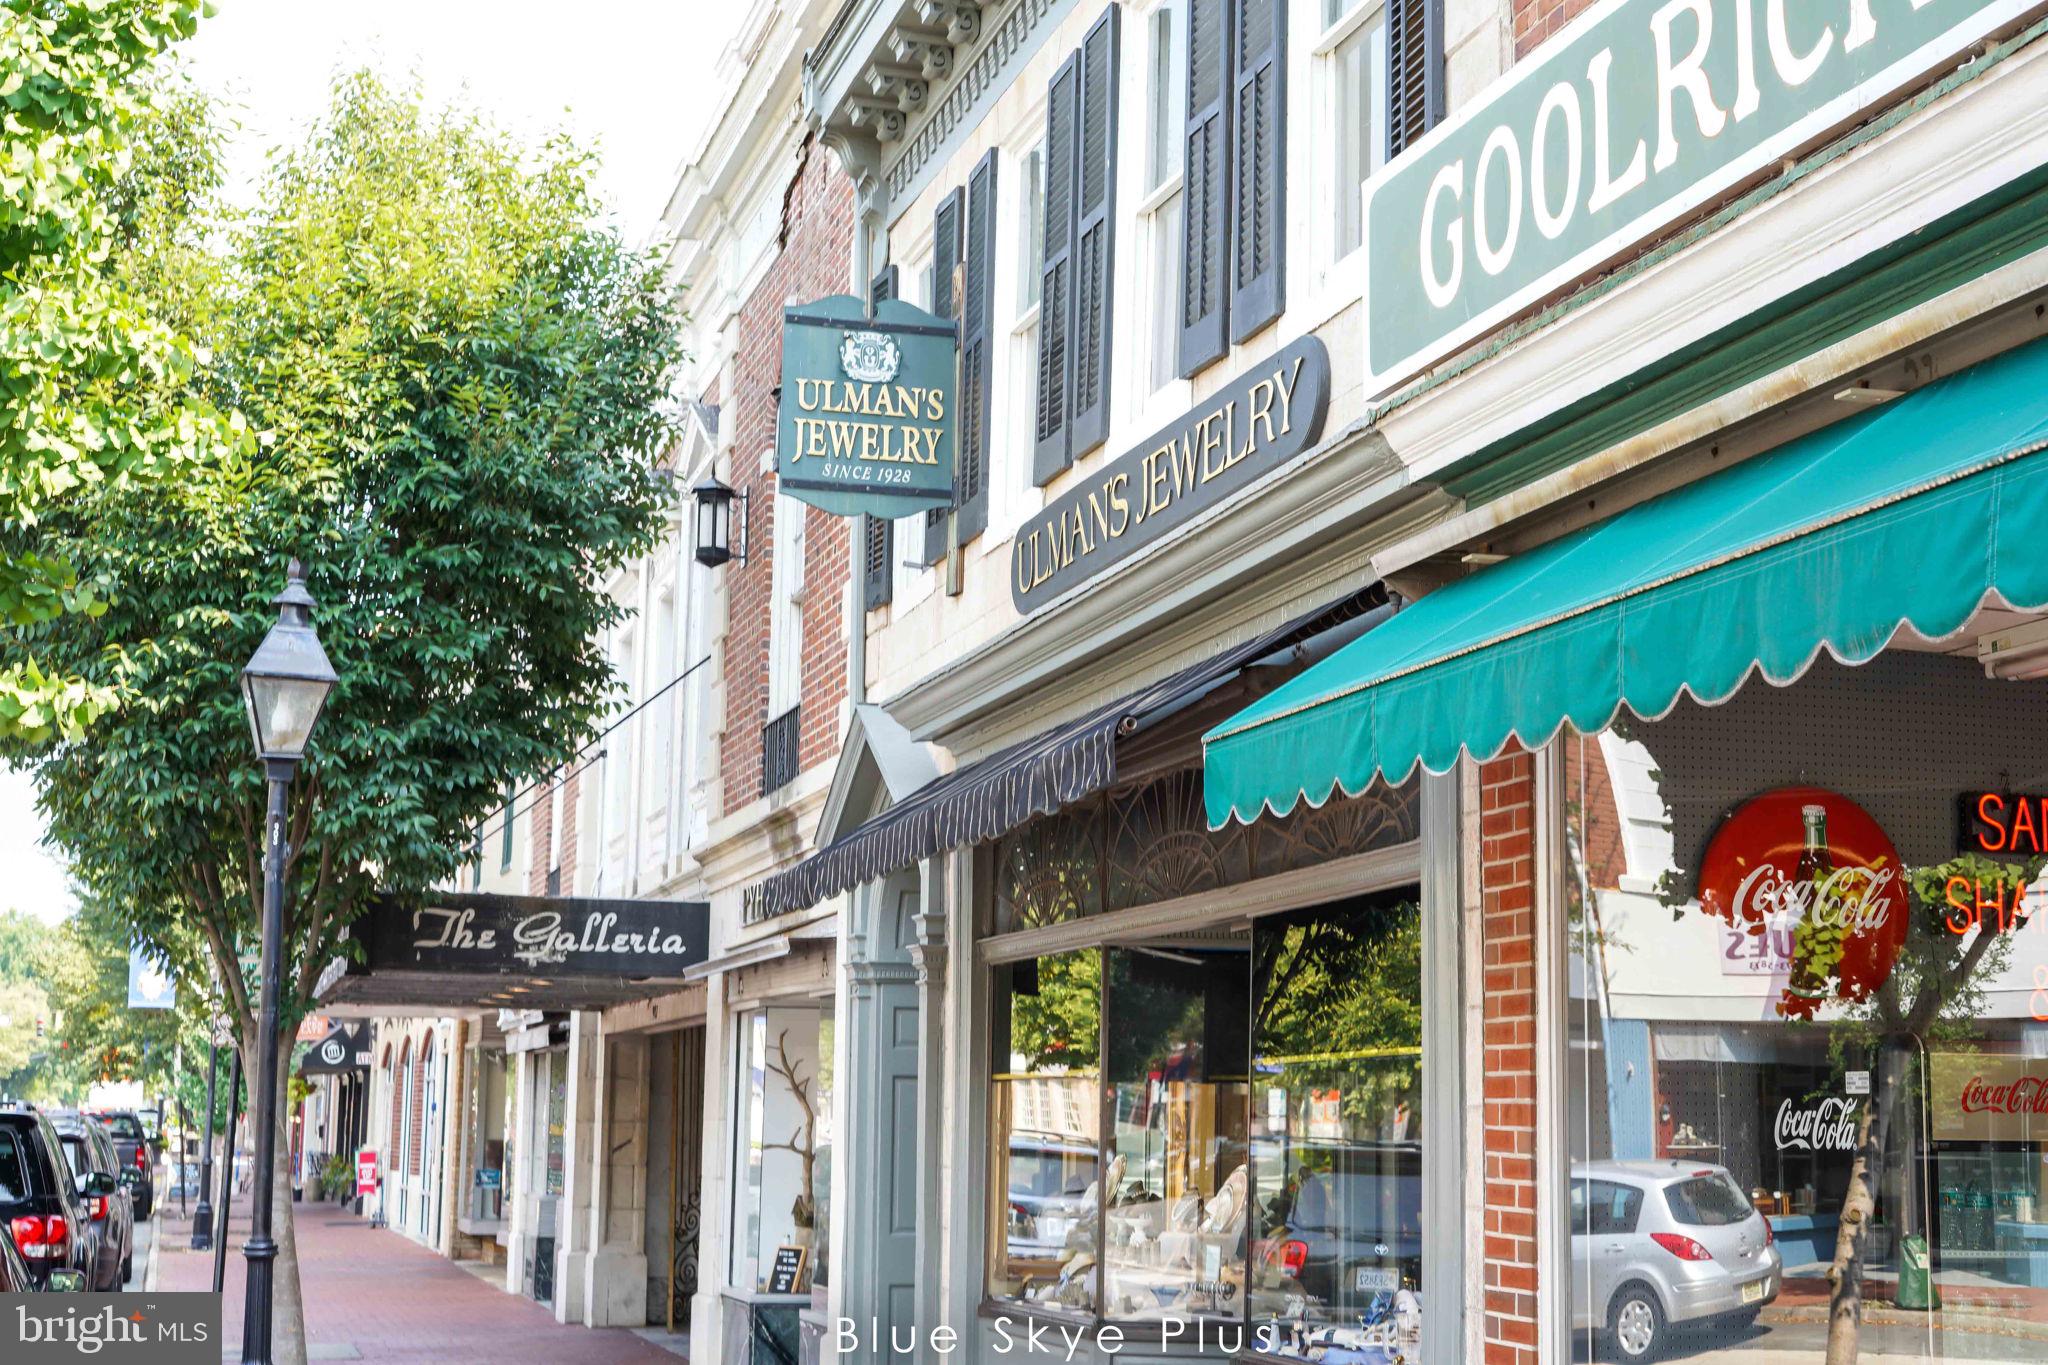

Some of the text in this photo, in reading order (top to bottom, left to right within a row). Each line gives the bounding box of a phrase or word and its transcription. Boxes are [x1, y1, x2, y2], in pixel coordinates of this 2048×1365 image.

[1419, 0, 1934, 309] GOOLRIC
[795, 377, 944, 421] ULMAN'S
[791, 417, 944, 465] JEWELRY
[822, 463, 912, 484] SINCE 1928
[1016, 356, 1303, 594] ULMAN'S JEWELRY
[1977, 793, 2048, 853] SA
[413, 906, 687, 957] The Galleria
[1946, 875, 2048, 935] SHA
